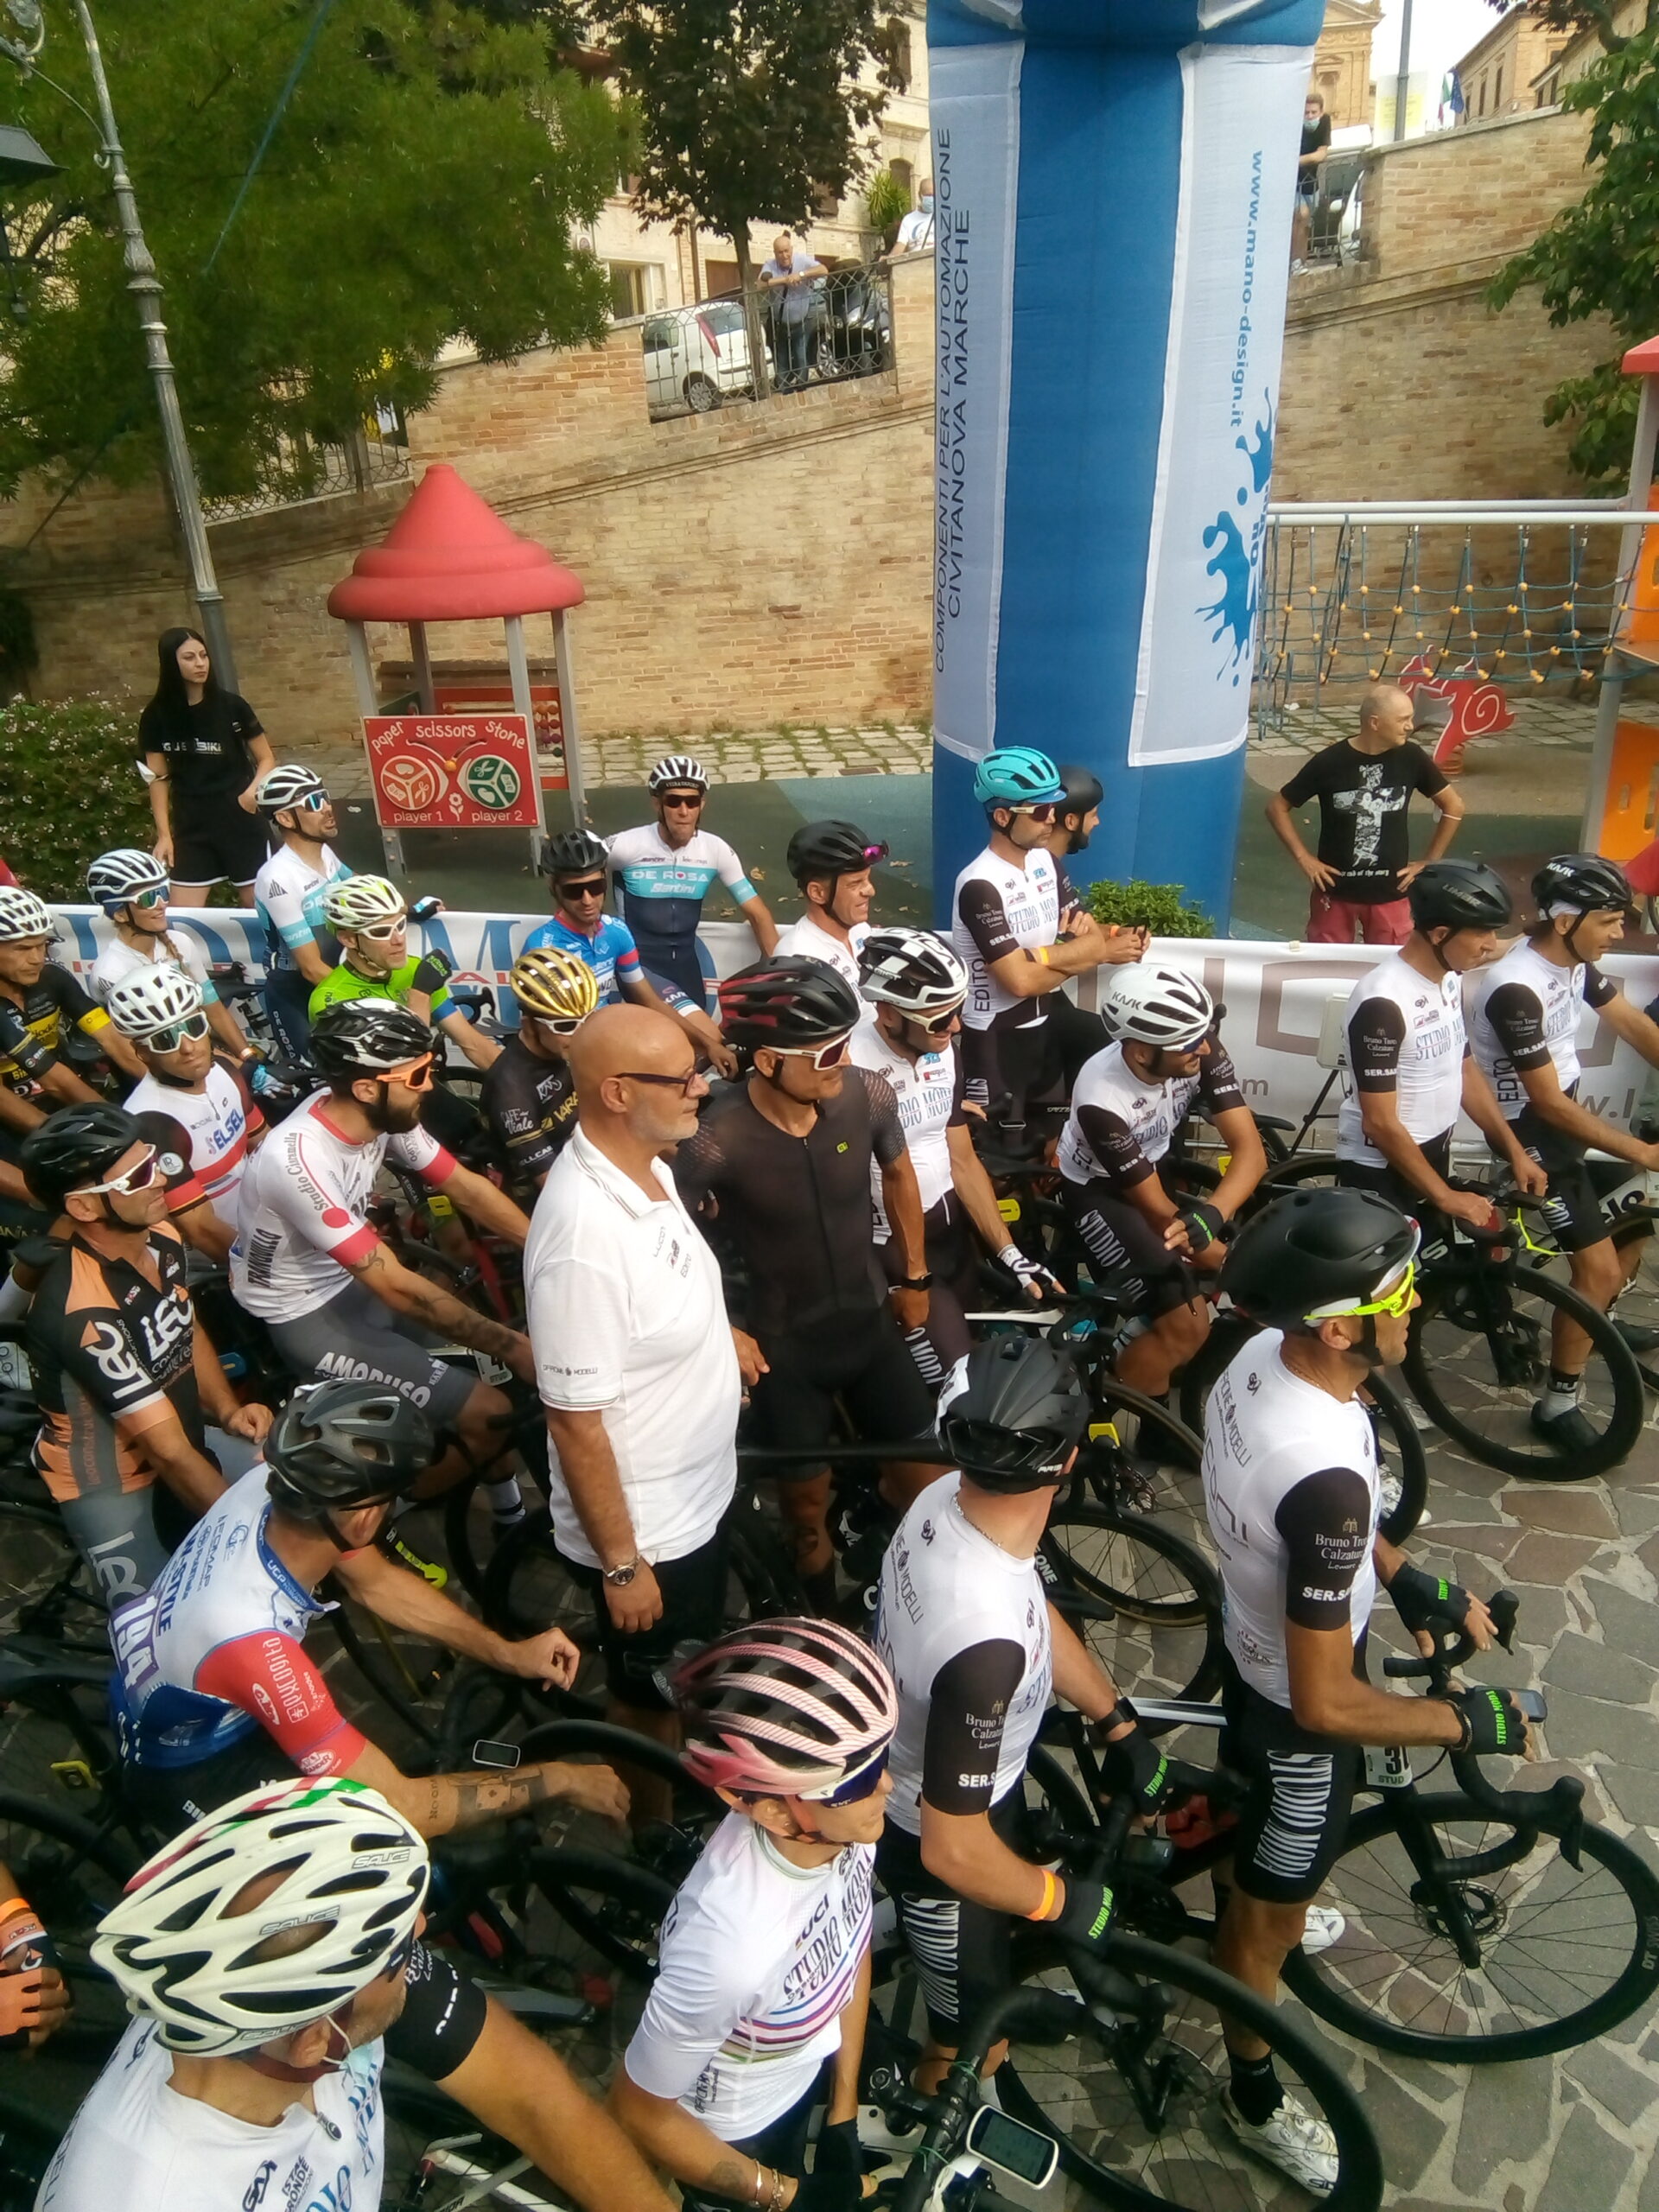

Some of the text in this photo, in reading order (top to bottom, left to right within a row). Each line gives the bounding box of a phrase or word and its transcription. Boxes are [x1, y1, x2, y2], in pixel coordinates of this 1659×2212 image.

[1230, 149, 1262, 428] www.mano-design.it
[936, 127, 952, 672] COMPONENTI PER L'AUTOMAZIONE
[948, 209, 969, 619] CIVITANOVA MARCHE
[393, 810, 443, 823] player 1
[471, 810, 523, 823] player 2
[632, 870, 658, 880] DE
[297, 1176, 329, 1211] Studio
[1074, 1209, 1126, 1268] STUDIO
[1314, 1533, 1351, 1548] Bruno
[965, 1713, 996, 1727] Bruno
[1494, 1711, 1507, 1745] STUDIO
[1267, 1749, 1334, 1827] STUDIO
[351, 1848, 411, 1869] SALICE
[259, 1904, 340, 1936] SALICE
[801, 1892, 830, 1941] UCI
[1088, 1909, 1109, 1940] STUDIO
